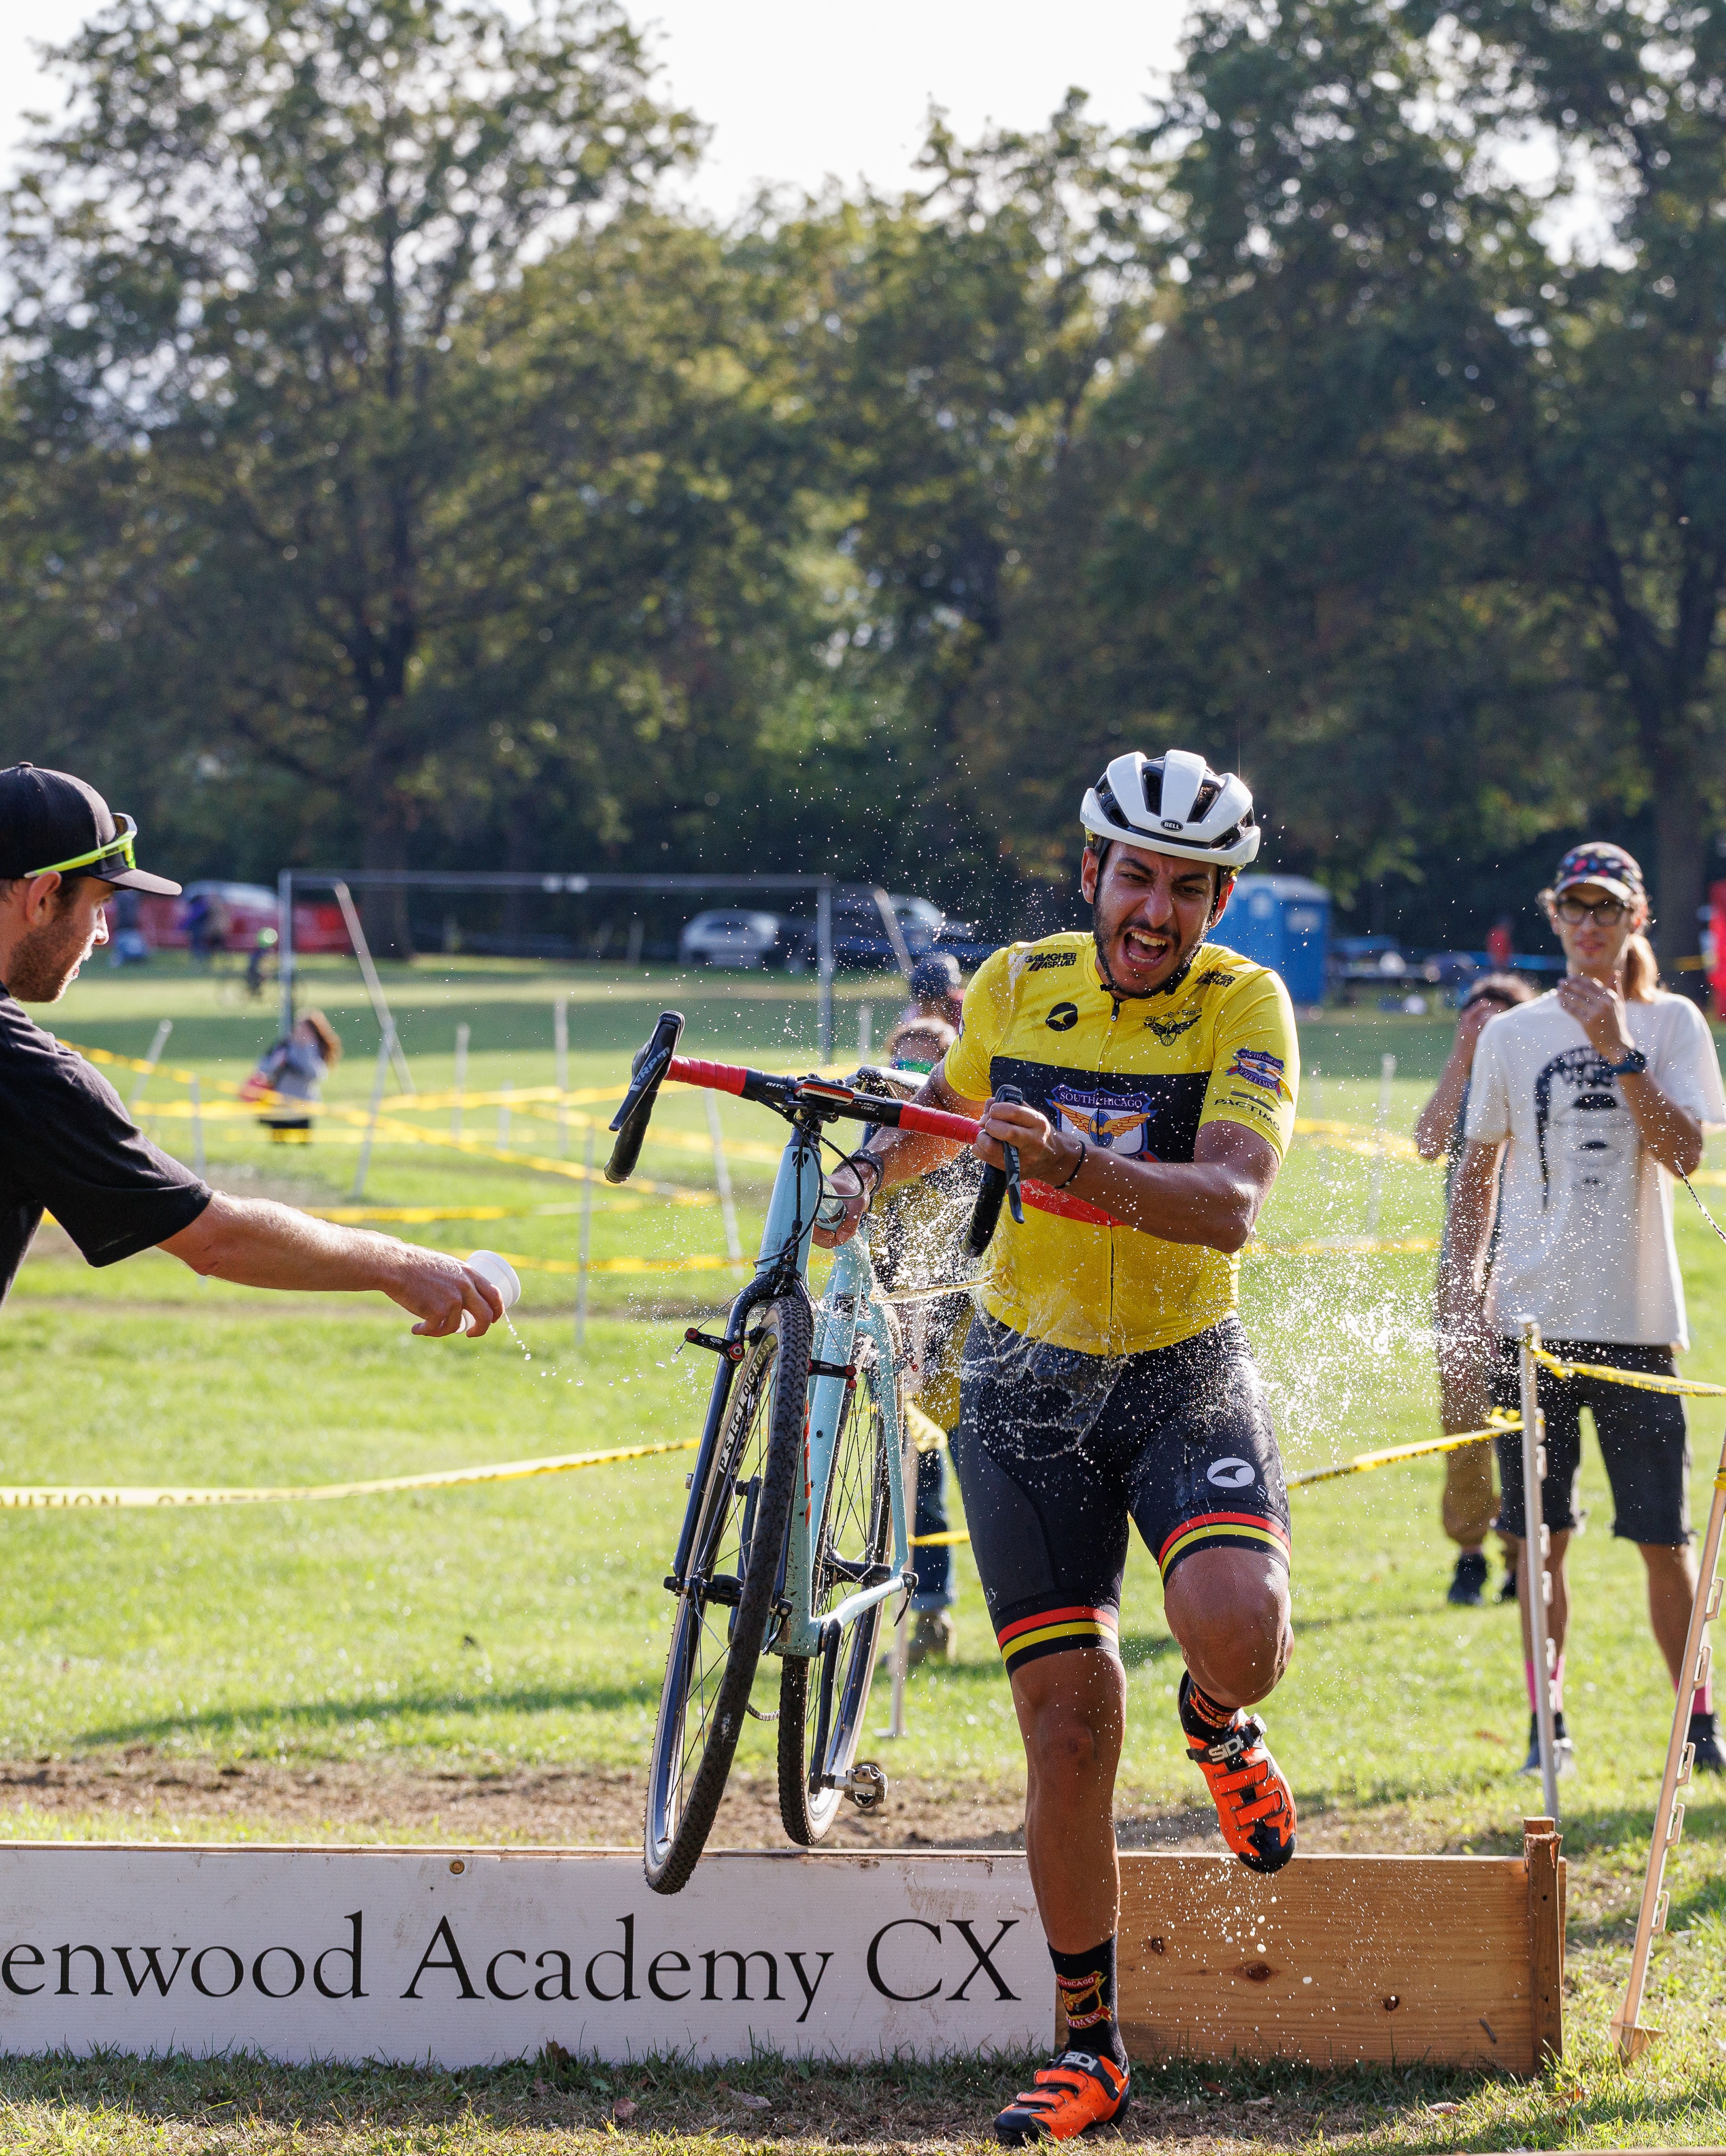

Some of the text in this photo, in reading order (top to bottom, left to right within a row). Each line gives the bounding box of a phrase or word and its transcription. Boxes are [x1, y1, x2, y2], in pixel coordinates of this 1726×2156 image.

[1024, 952, 1077, 963] GALLAGHER
[1040, 960, 1077, 969] ASPHALT
[1262, 1056, 1282, 1067] CHICAGO
[1239, 1069, 1276, 1089] WHEELMEN
[1060, 1092, 1142, 1107] SOUTH CHICAGO
[1214, 1099, 1280, 1131] PACTIMO
[1209, 1735, 1245, 1762] SIDI
[2, 1910, 1021, 2022] enwood Academy CX
[1061, 2052, 1098, 2072] SIDI
